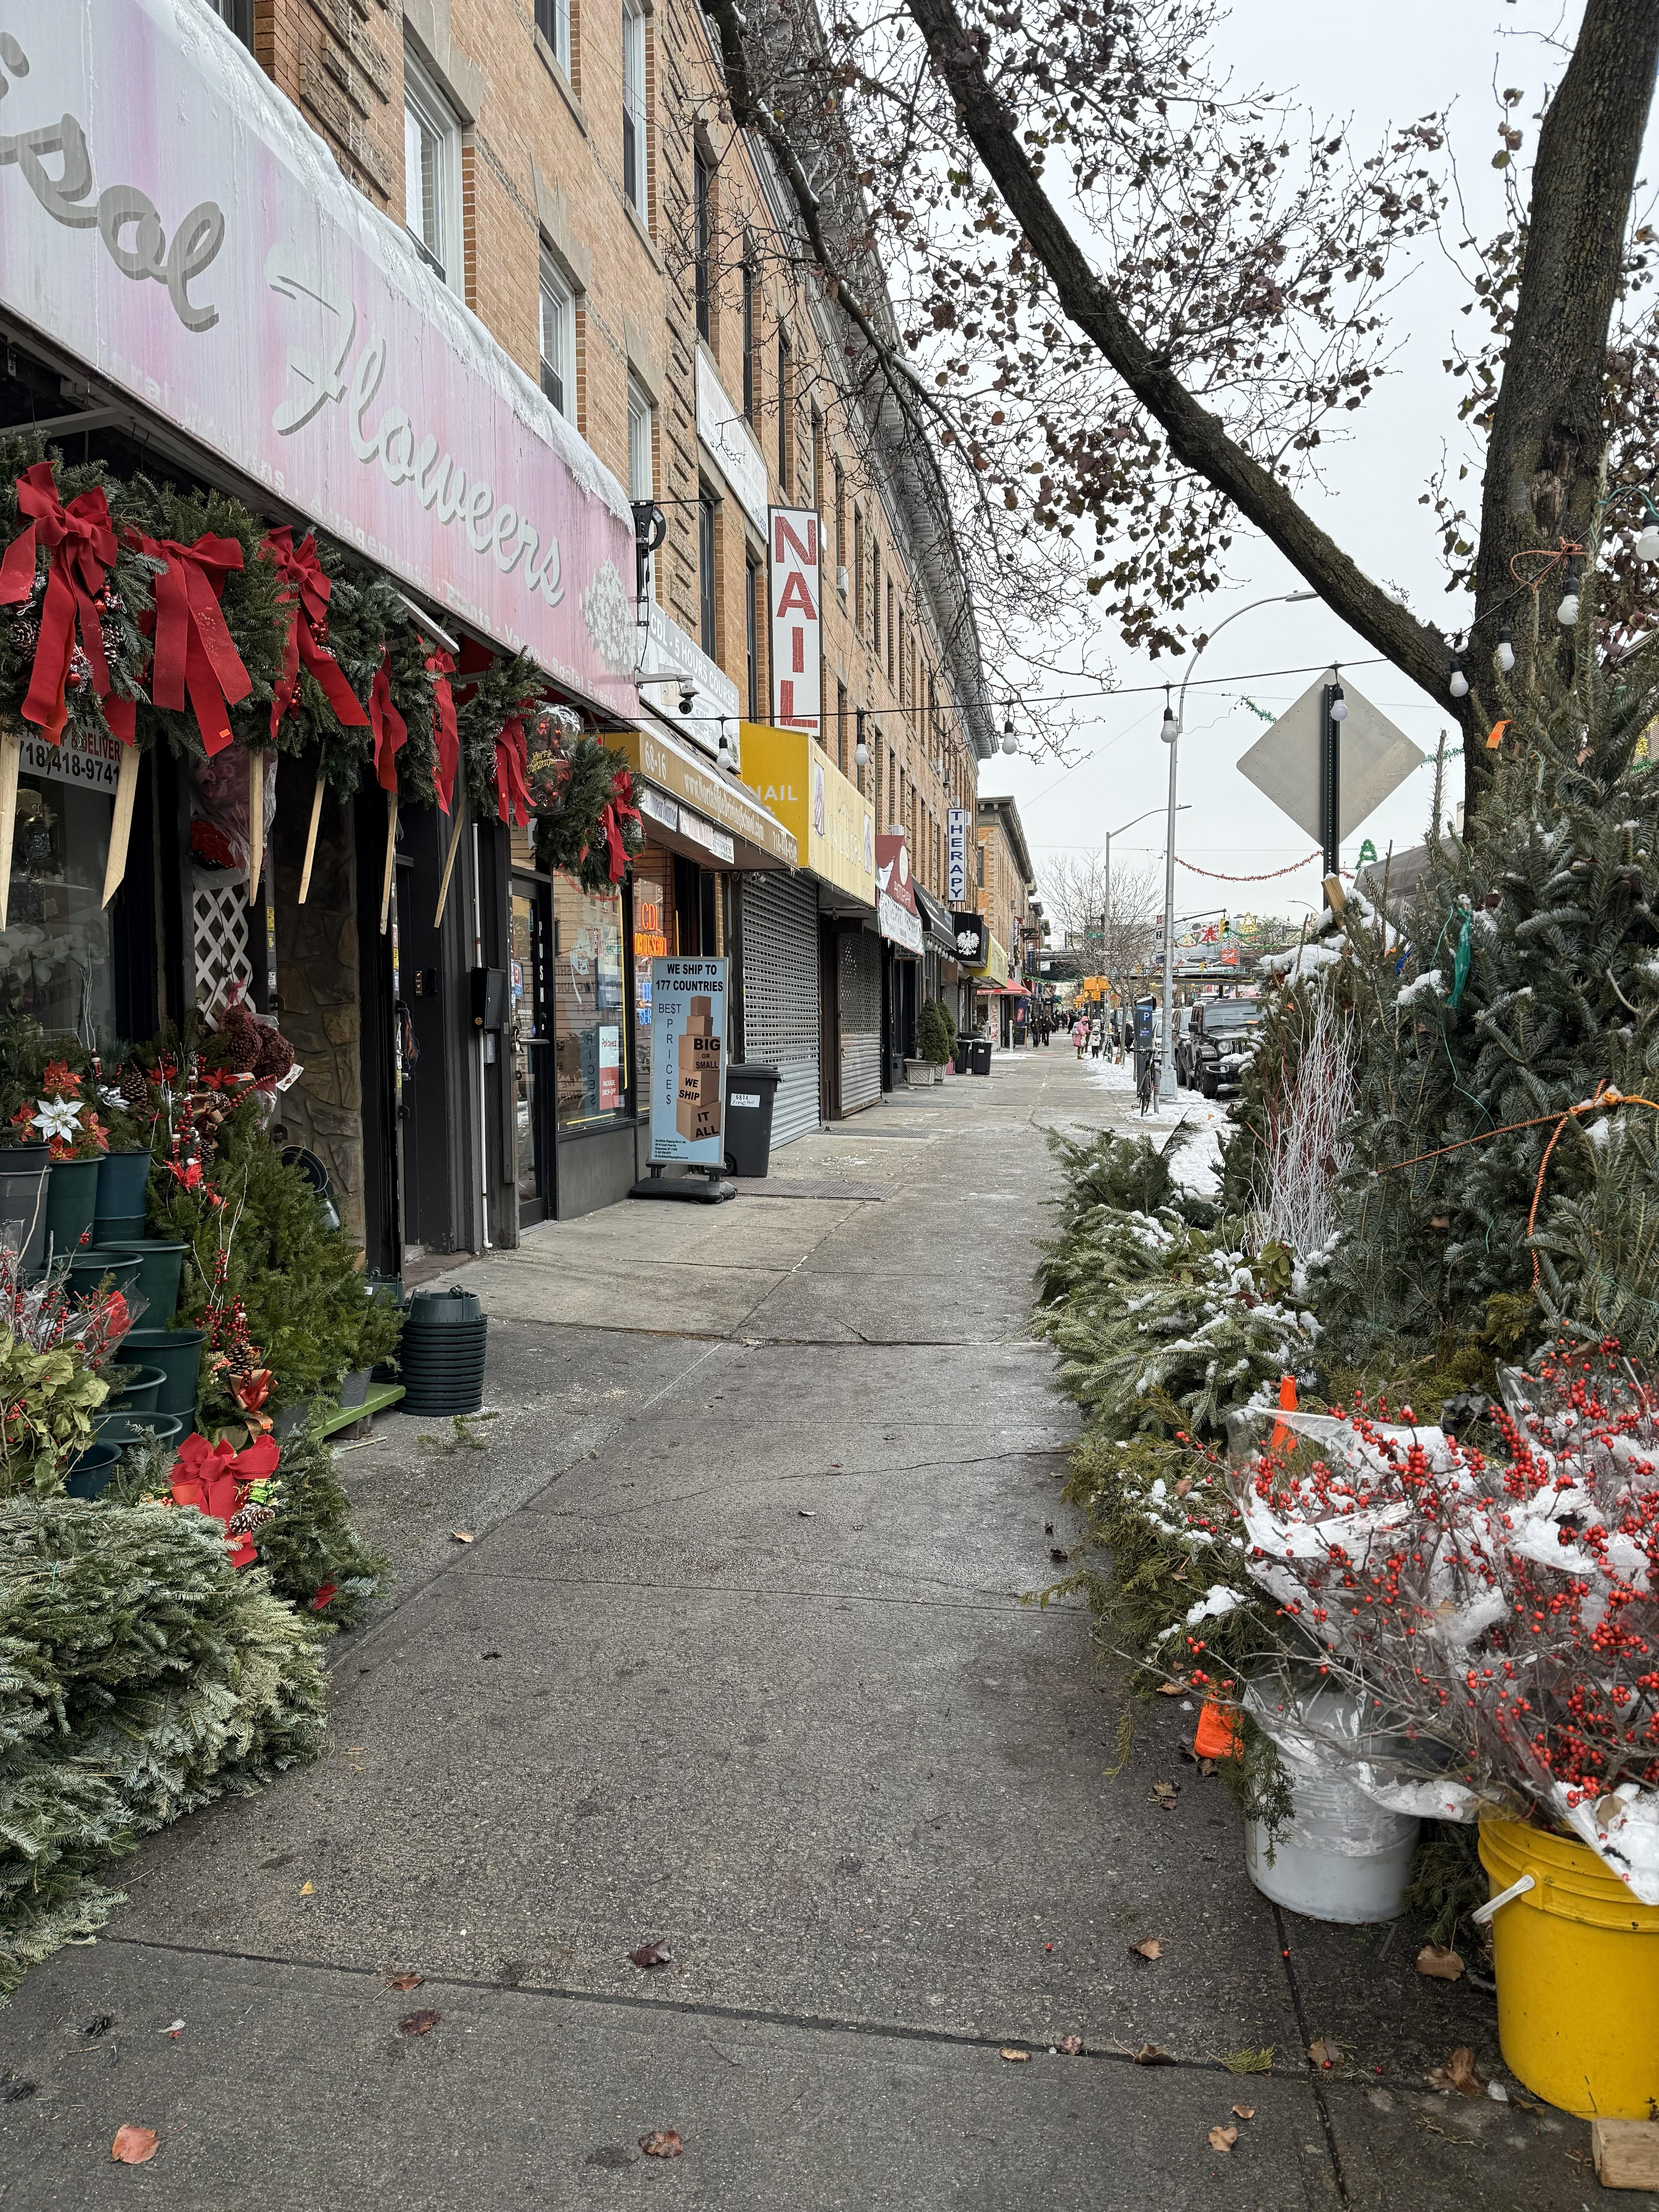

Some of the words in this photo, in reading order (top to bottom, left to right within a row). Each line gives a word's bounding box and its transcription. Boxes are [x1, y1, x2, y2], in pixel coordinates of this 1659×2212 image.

[775, 516, 818, 728] NAIL
[650, 612, 668, 647] CDL
[675, 636, 680, 658] 5
[682, 644, 708, 684] HOURS
[709, 670, 735, 711] COURSE
[552, 656, 584, 690] Social
[588, 680, 618, 711] Events
[645, 741, 666, 781] 68-16
[747, 785, 798, 801] NAIL
[950, 811, 963, 898] THERAPY
[642, 902, 661, 931] CDL
[667, 964, 680, 974] WE
[683, 964, 702, 975] SHIP
[706, 964, 717, 975] TO
[656, 980, 671, 990] 177
[673, 981, 723, 991] COUNTRIES
[659, 1003, 682, 1014] BE$T
[1144, 1012, 1150, 1021] P
[602, 1038, 617, 1047] Polonez
[694, 1038, 720, 1051] BIG
[685, 1077, 698, 1088] WE
[679, 1089, 700, 1101] SHIP
[697, 1111, 709, 1122] IT
[696, 1125, 719, 1138] ALL
